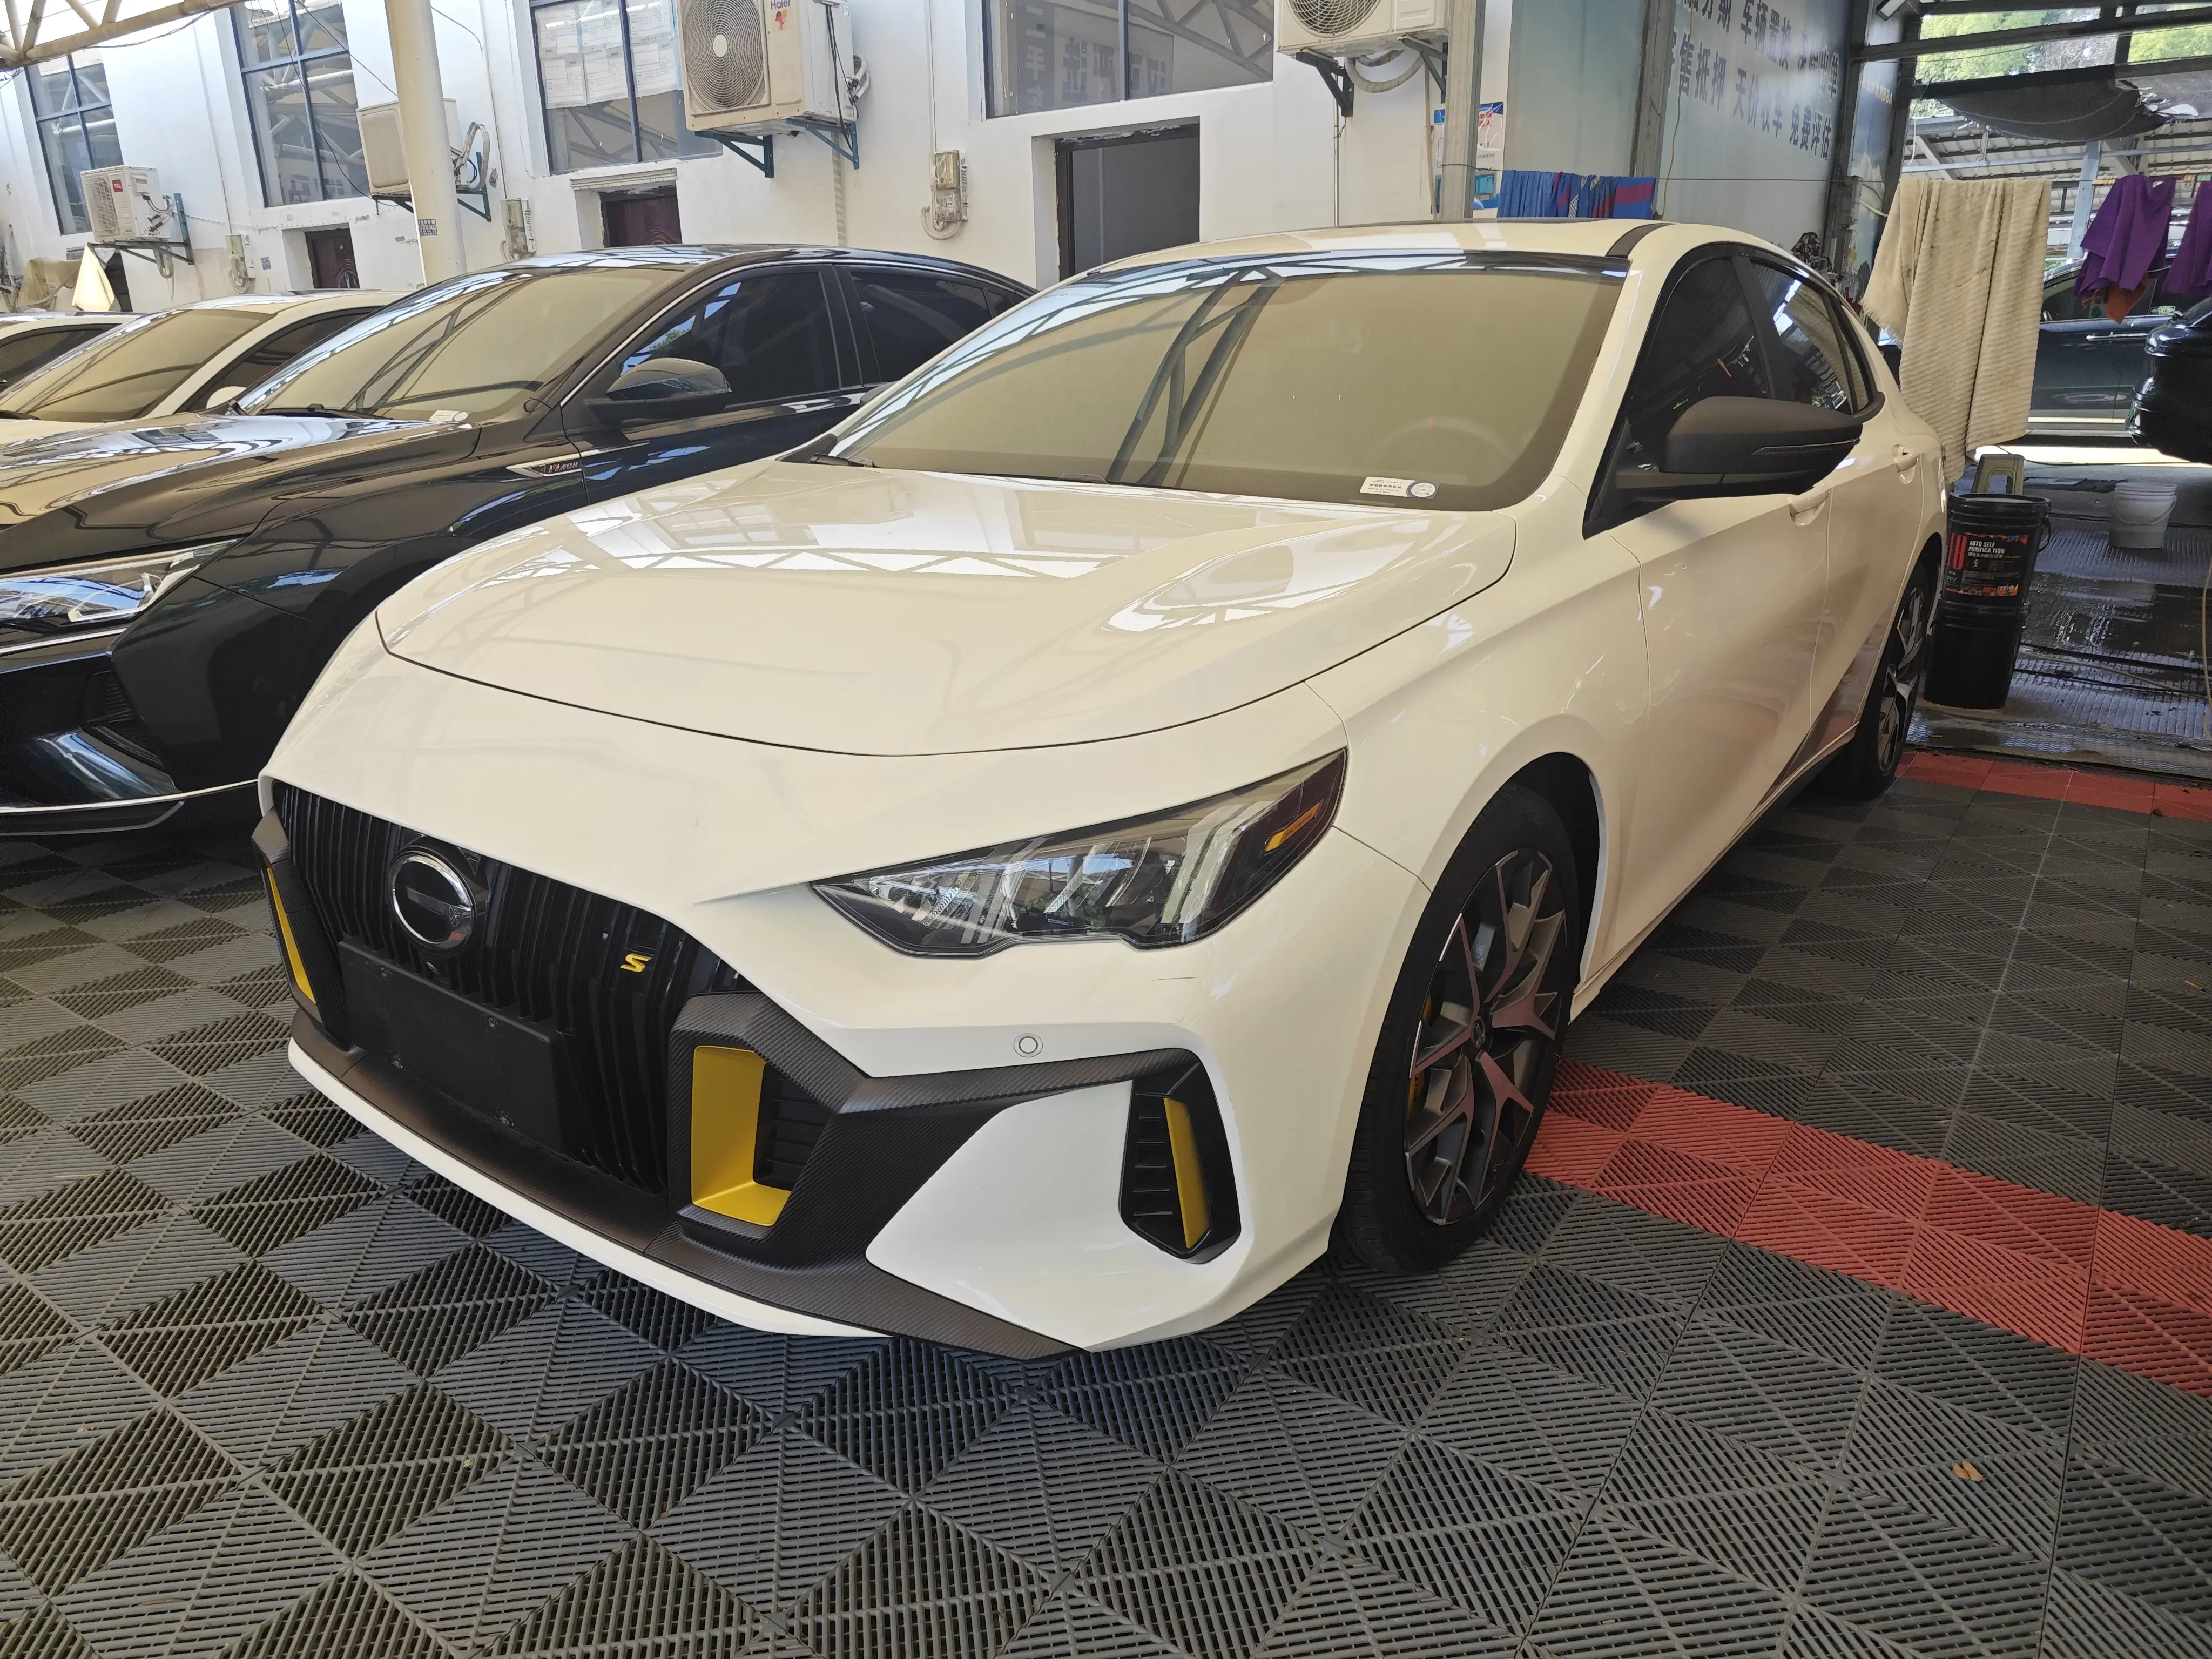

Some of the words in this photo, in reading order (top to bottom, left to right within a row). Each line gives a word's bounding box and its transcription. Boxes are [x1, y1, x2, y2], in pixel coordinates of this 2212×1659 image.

[771, 0, 791, 10] Haier
[1669, 31, 1727, 111] 售抵押
[1789, 100, 1832, 161] 免费评估
[620, 953, 652, 973] S
